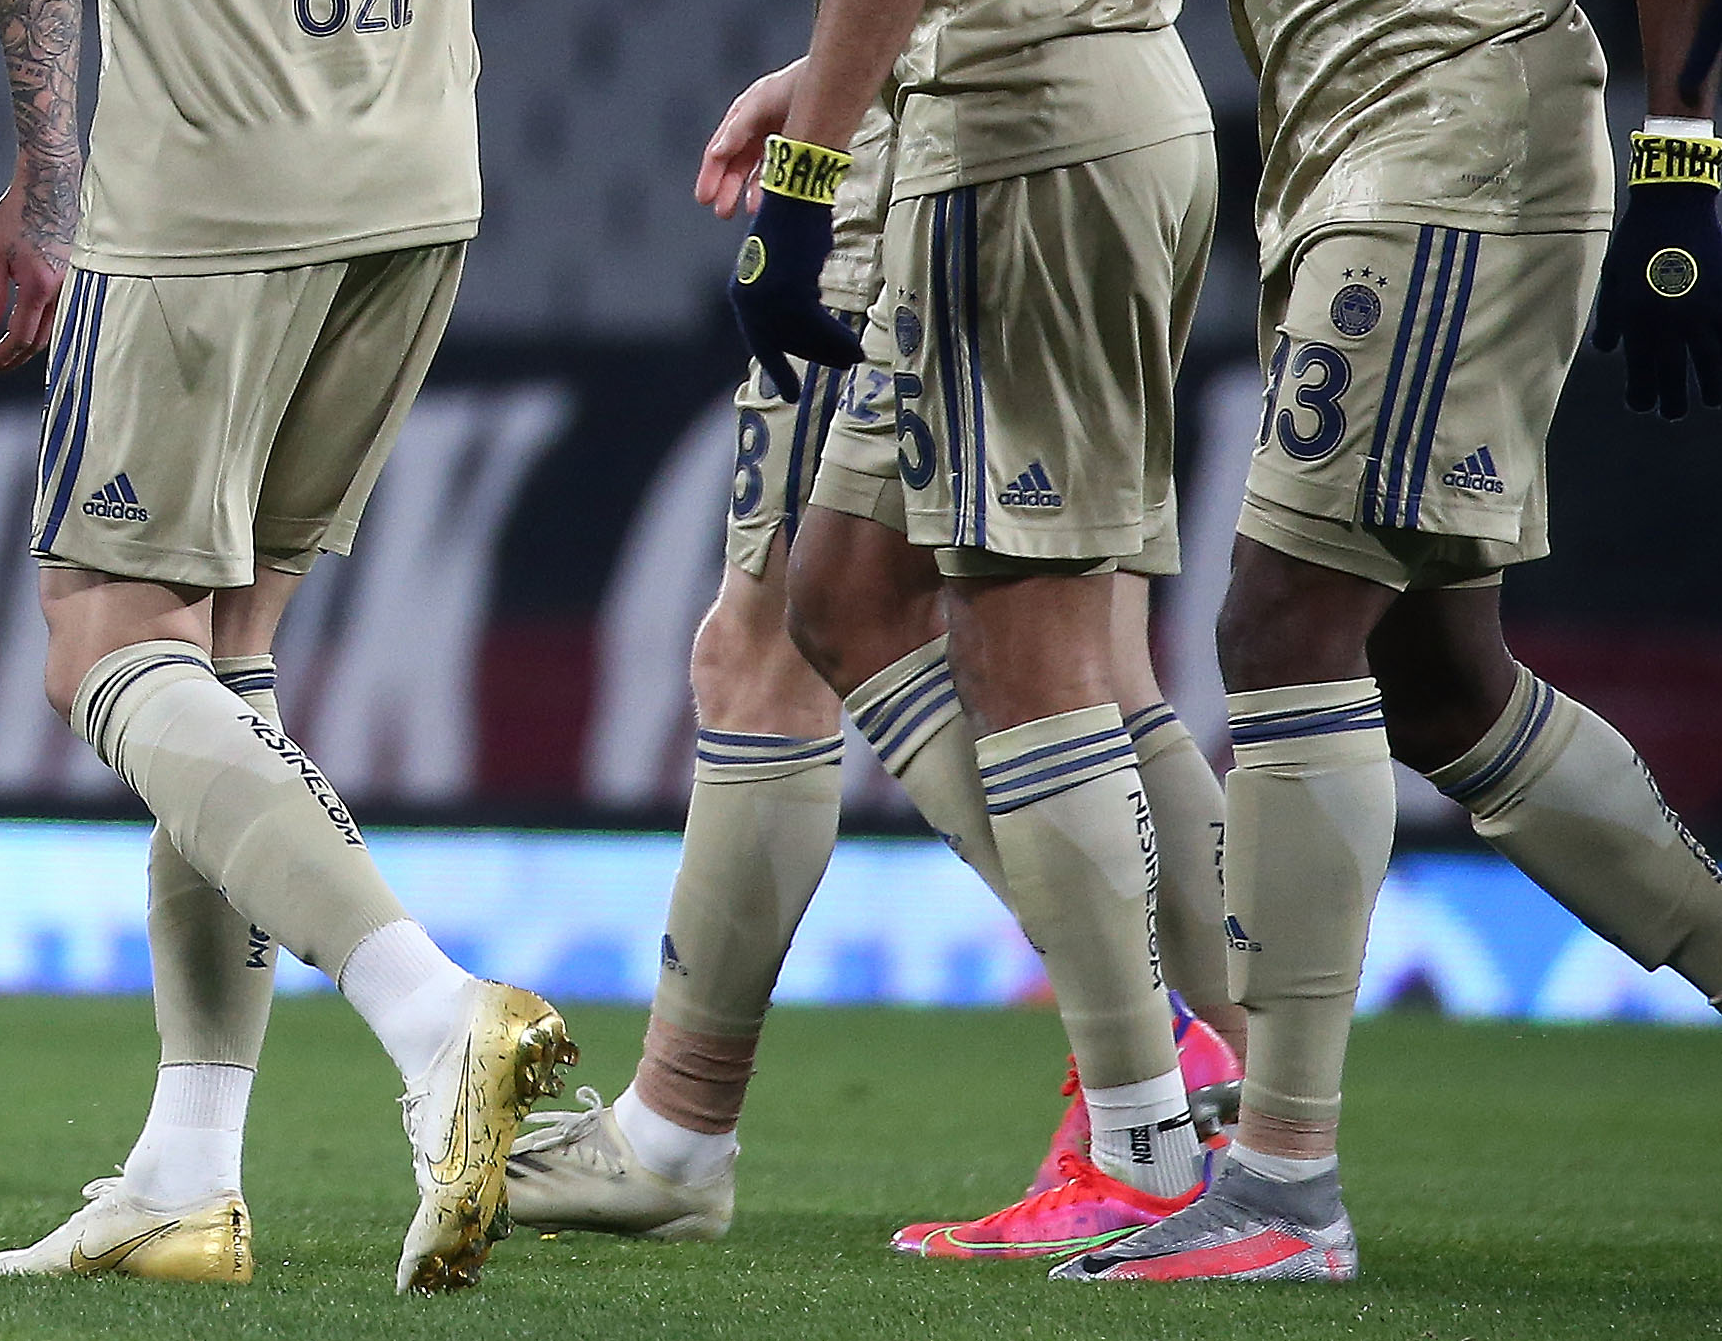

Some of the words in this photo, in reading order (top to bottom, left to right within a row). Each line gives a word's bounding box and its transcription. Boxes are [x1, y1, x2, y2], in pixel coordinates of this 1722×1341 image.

[1442, 470, 1504, 495] adidas
[82, 499, 148, 522] adidas
[998, 489, 1062, 509] adidas
